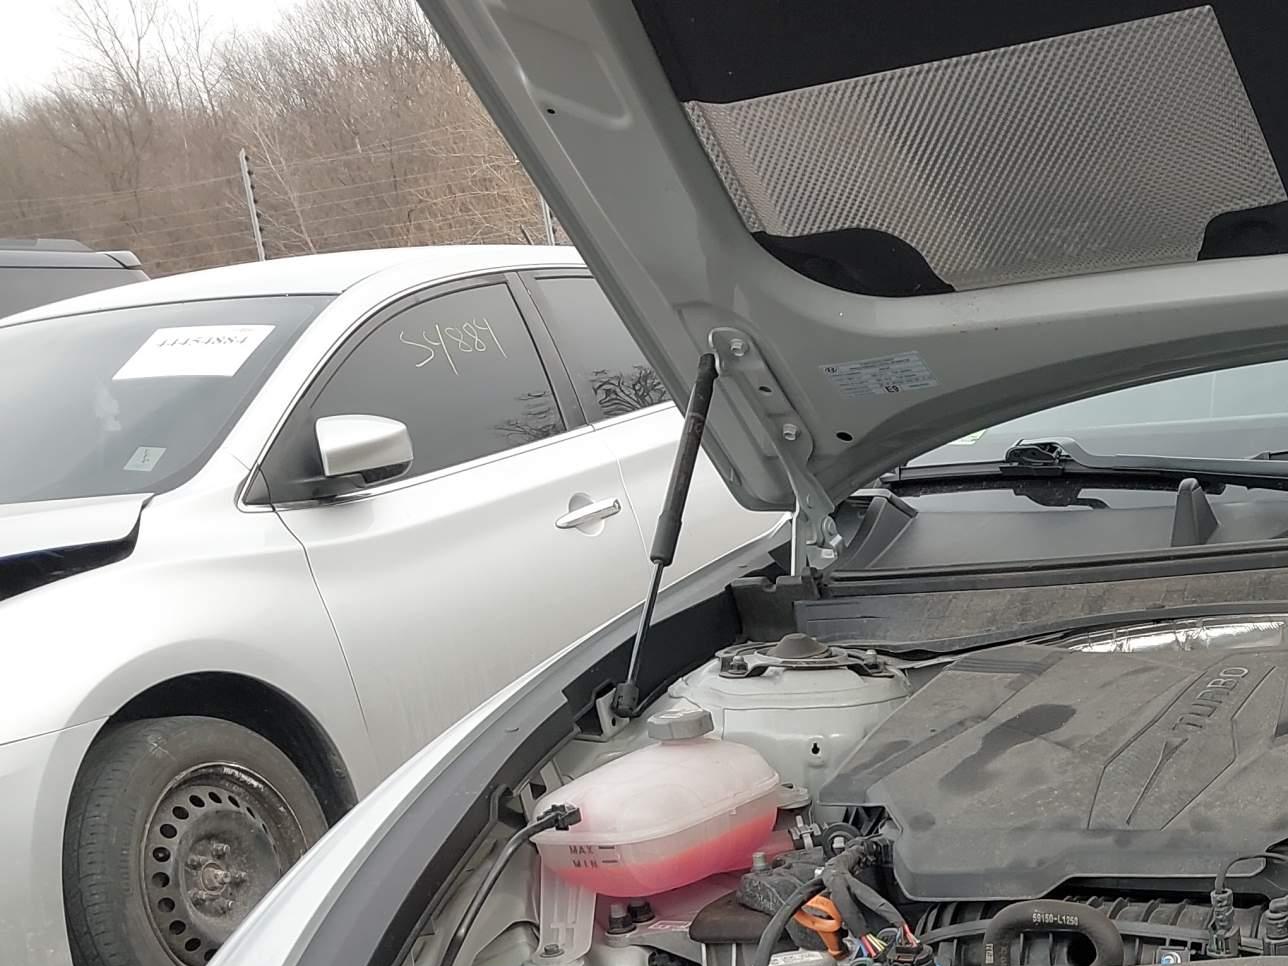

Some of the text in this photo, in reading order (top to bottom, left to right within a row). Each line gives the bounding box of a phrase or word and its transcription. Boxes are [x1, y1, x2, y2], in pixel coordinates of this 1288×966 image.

[1172, 667, 1249, 731] TURBO
[568, 844, 595, 855] MAX
[572, 859, 599, 869] MIN
